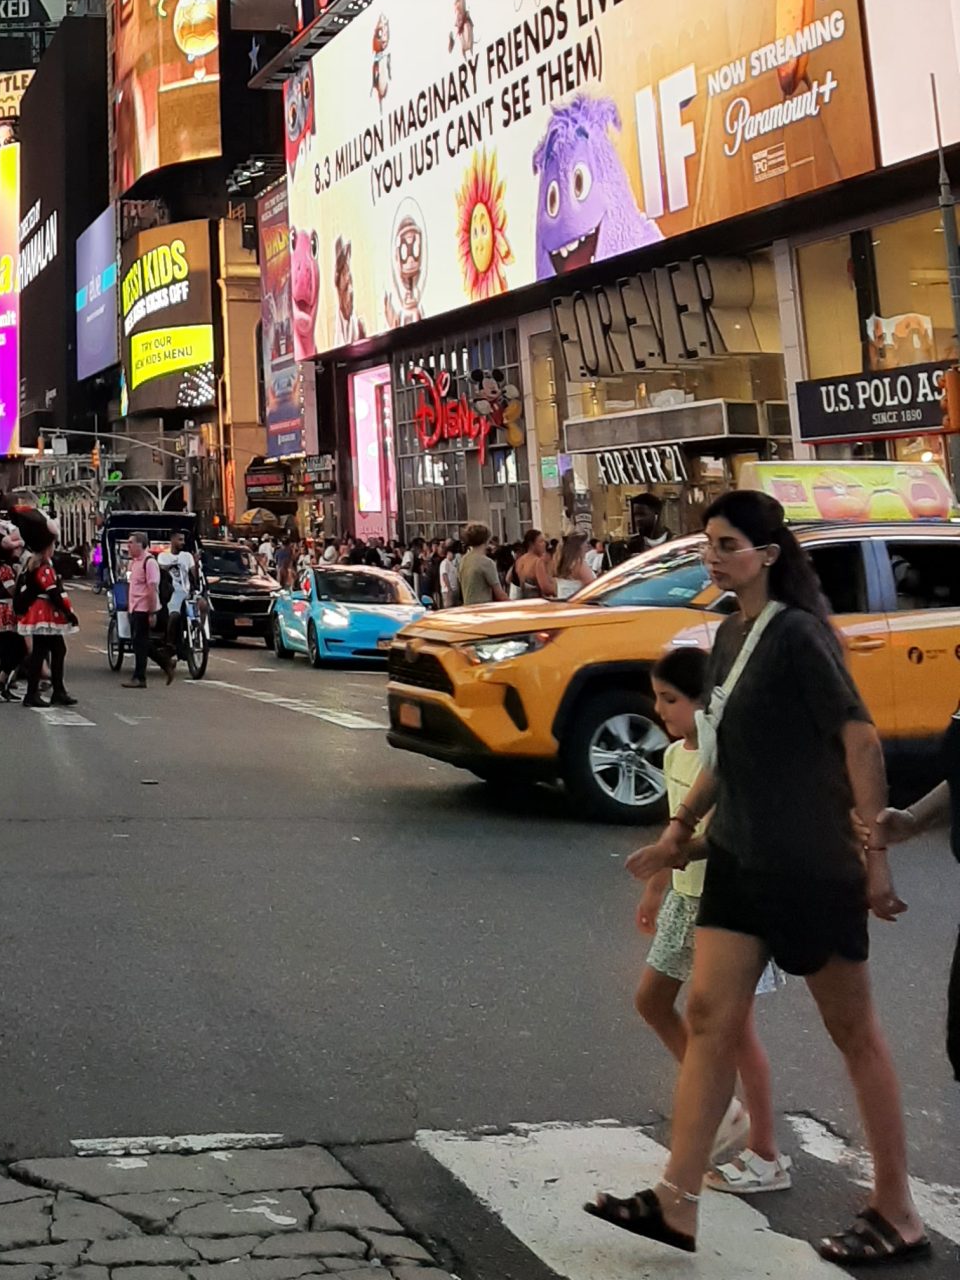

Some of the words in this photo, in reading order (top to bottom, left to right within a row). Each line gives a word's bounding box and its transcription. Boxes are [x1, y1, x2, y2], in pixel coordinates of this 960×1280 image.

[707, 56, 746, 98] NOW
[751, 10, 845, 77] STREAMING
[314, 155, 333, 194] 8.3
[335, 123, 385, 181] MILLION
[388, 54, 480, 146] IMAGINARY
[370, 162, 403, 206] (YOU
[408, 131, 440, 180] JUST
[445, 98, 495, 157] CAN'T
[501, 78, 533, 128] SEE
[536, 26, 603, 106] THEM)
[634, 63, 699, 220] IF
[723, 70, 838, 157] Paramount+
[143, 239, 189, 292] KIDS
[169, 280, 190, 304] OFF
[154, 335, 172, 349] OUR
[551, 255, 730, 383] FOREVER
[145, 352, 161, 366] KIDS
[163, 346, 193, 361] MENU
[819, 383, 855, 413] U.S.
[856, 374, 913, 409] POLO
[916, 369, 947, 403] AS
[407, 366, 492, 466] Disney
[871, 411, 899, 425] SINCE
[901, 409, 923, 422] 1890
[596, 446, 668, 486] FOREVER
[666, 445, 688, 482] 21
